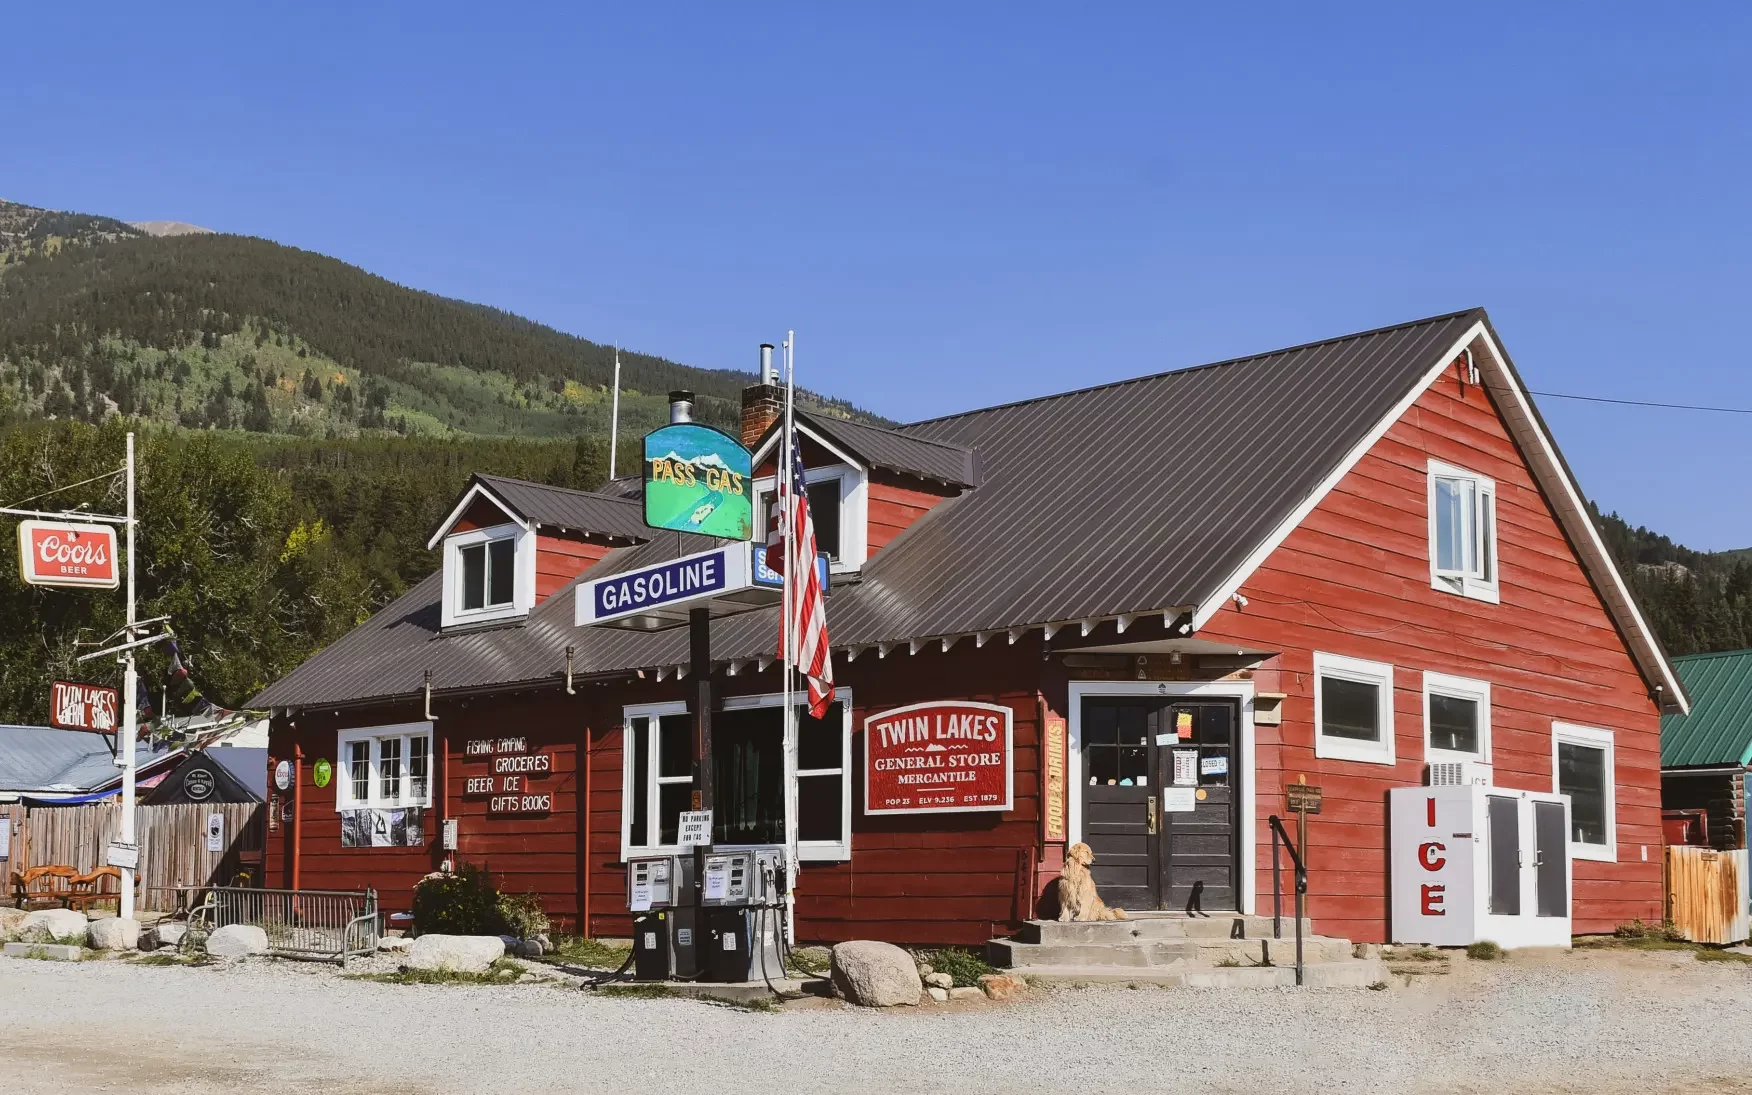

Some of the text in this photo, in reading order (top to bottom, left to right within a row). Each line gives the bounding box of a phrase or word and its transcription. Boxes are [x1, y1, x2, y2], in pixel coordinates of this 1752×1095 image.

[652, 459, 744, 495] PASS GAS
[36, 535, 107, 565] Coors
[60, 565, 88, 575] BEER
[602, 559, 716, 611] GASOLINE
[55, 683, 115, 727] TWIN LAKES
[876, 714, 999, 748] TWIN LAKES
[1048, 725, 1062, 777] DRINKS
[874, 752, 1001, 771] GENERAL STORE
[1200, 760, 1218, 768] LOSED
[467, 776, 520, 793] BEER ICE
[898, 771, 976, 785] MERCANTILE
[491, 795, 550, 812] GIFTS BOOKS
[885, 798, 900, 806] POP
[918, 796, 932, 805] ELV
[963, 793, 998, 803] EST 1879
[682, 815, 689, 823] NO
[1048, 796, 1062, 834] FOOD
[685, 824, 702, 832] EXCEPT
[1417, 797, 1447, 916] ICE
